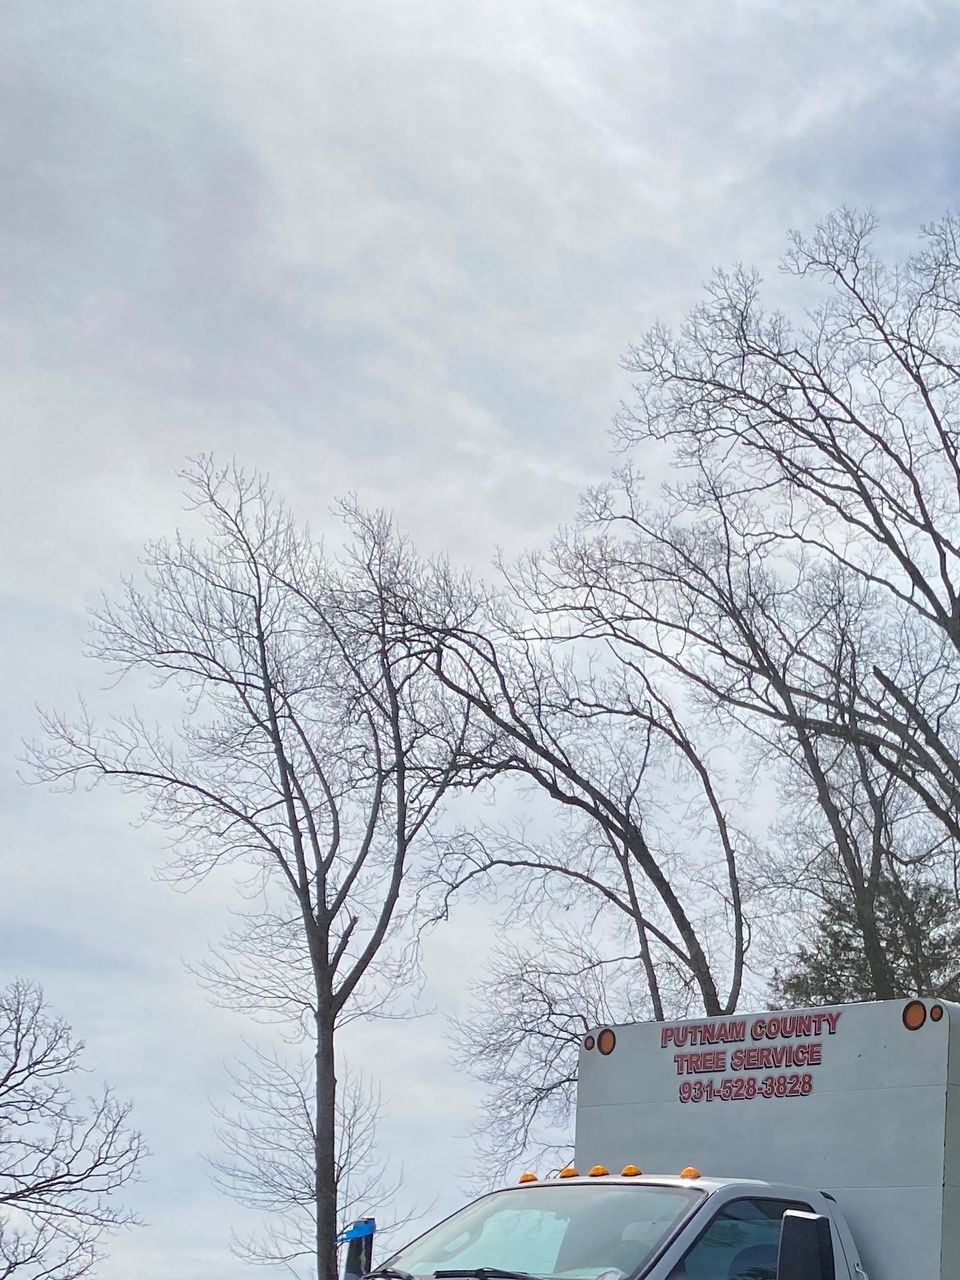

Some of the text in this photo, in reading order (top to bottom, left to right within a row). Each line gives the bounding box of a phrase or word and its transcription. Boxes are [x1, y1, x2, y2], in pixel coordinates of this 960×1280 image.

[661, 1012, 842, 1048] PUTNAM COUNTY
[674, 1043, 822, 1075] TREE SERVICE
[680, 1073, 813, 1103] 931-528-3828
